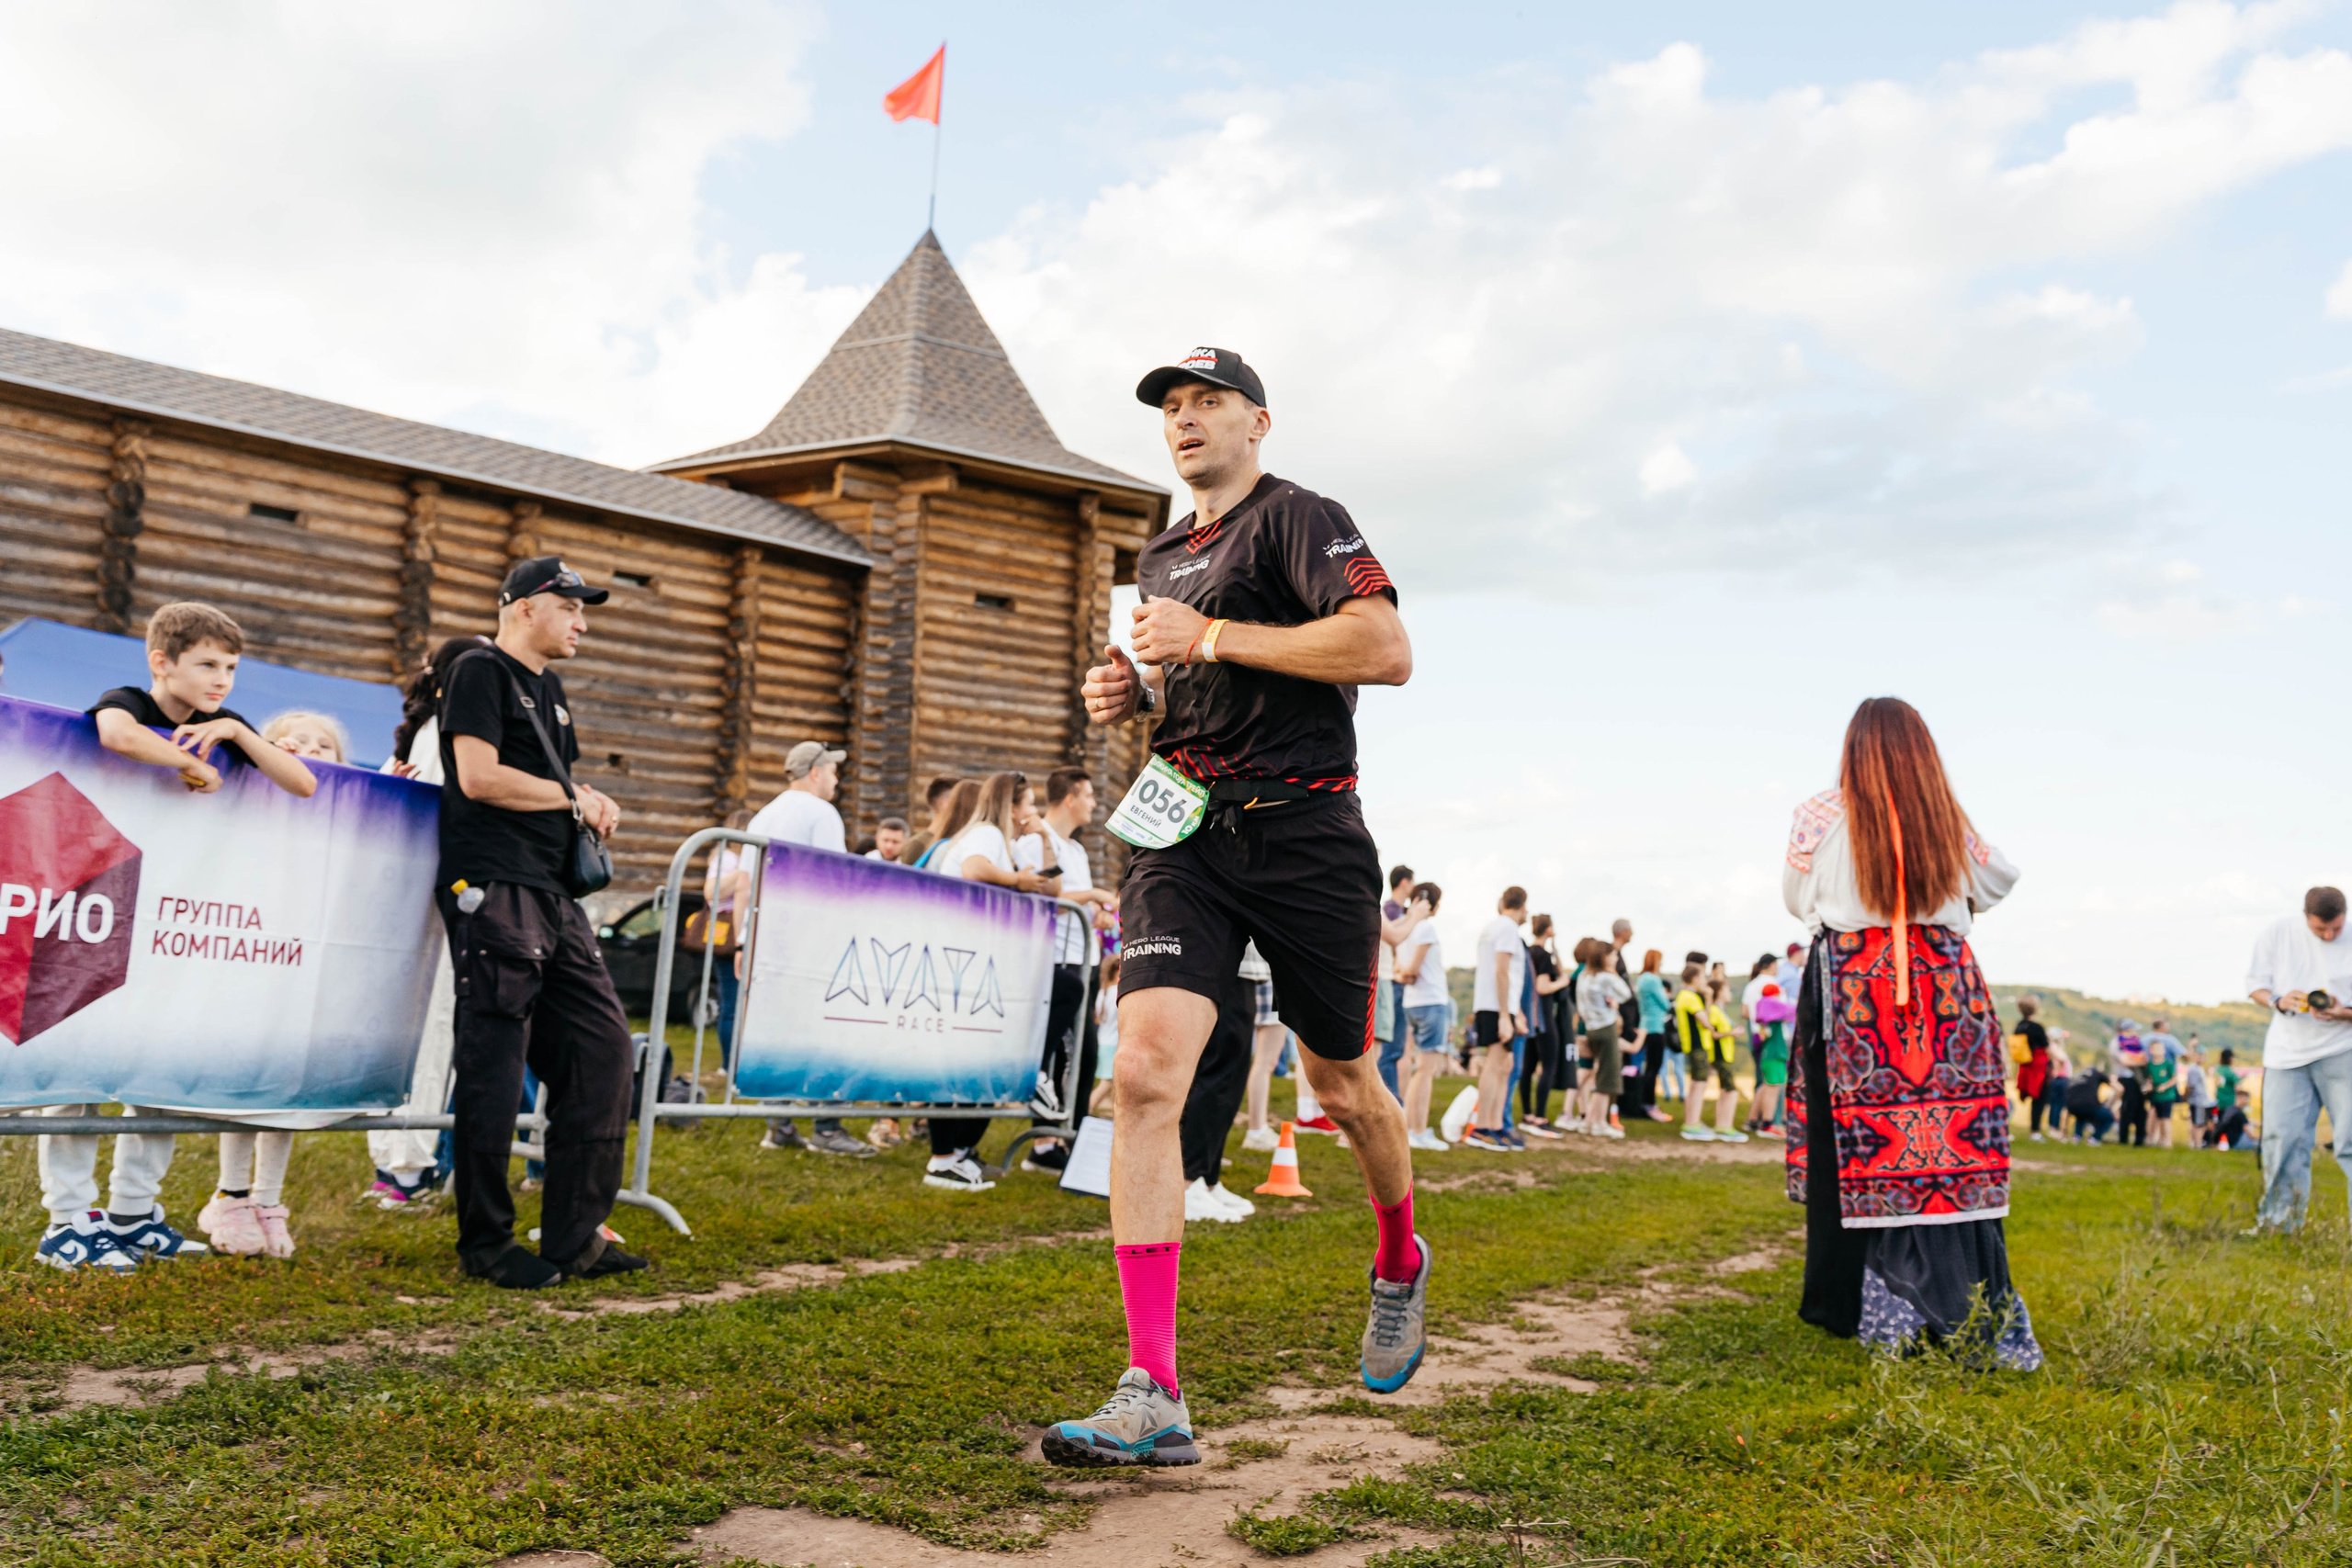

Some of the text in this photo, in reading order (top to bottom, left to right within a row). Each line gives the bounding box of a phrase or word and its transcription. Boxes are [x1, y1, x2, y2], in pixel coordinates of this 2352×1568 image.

[1138, 779, 1187, 824] 056
[1130, 805, 1162, 828] ЕВГЕНИЙ
[1181, 824, 1193, 835] 10
[158, 897, 264, 931] ГРУППА
[152, 930, 303, 967] КОМПАНИЙ
[1129, 935, 1181, 946] HERO LEAGUE
[1123, 942, 1182, 962] TRAINING
[897, 1014, 945, 1033] RACE
